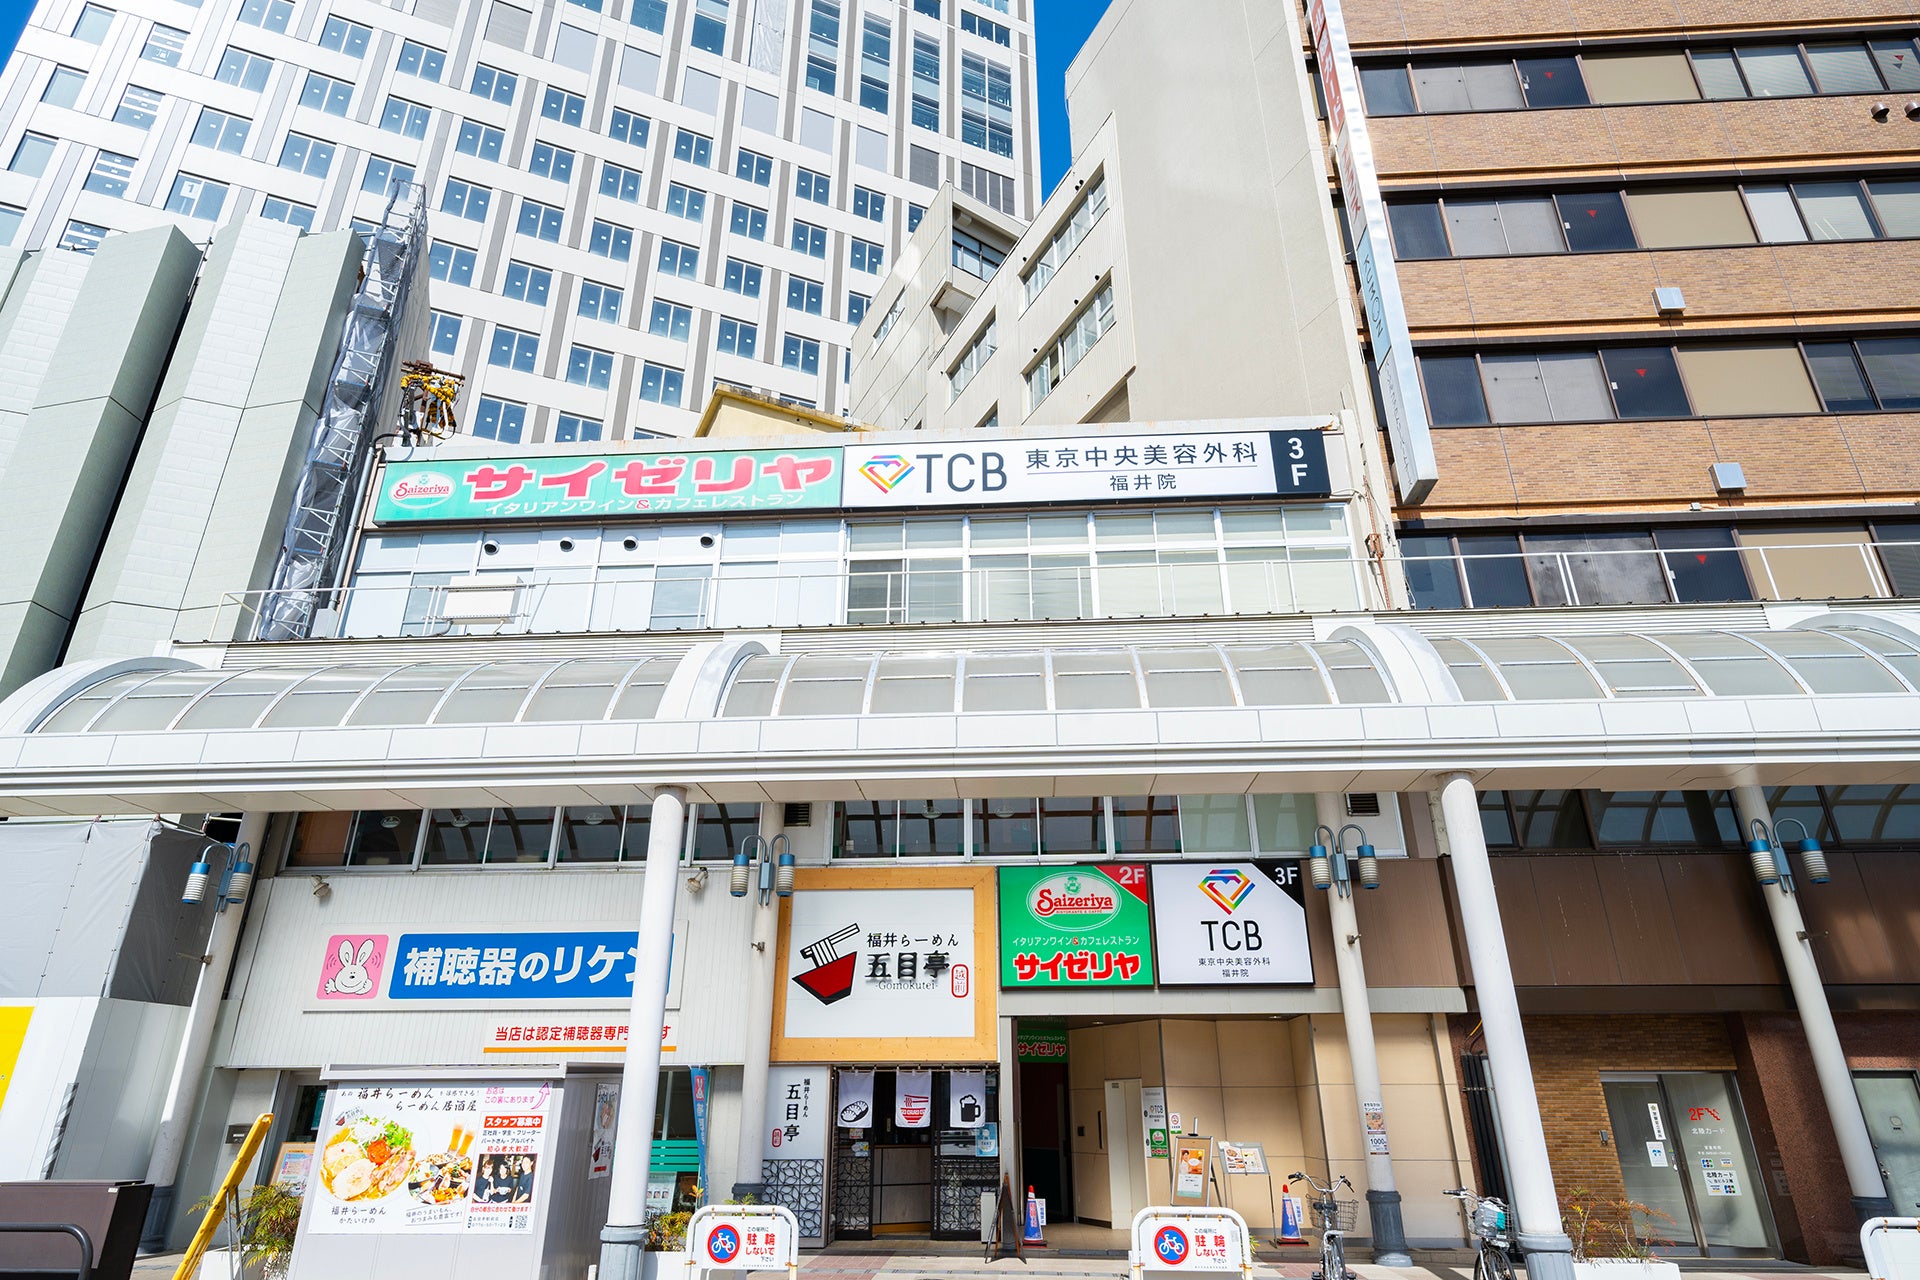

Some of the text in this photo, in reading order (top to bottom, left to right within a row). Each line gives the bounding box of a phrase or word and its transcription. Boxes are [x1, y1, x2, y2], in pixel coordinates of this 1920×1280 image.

[1363, 254, 1383, 338] KUMON
[1026, 442, 1258, 469] 東京中央美容外科
[465, 457, 834, 502] サイゼリヤ
[916, 452, 1008, 493] TCB
[394, 482, 450, 498] Saizeriya
[1109, 474, 1177, 491] 福井院
[485, 493, 804, 515] イタリアンワイン&カフェレストラン
[1119, 866, 1144, 884] 2F
[1275, 867, 1298, 885] 3F
[1035, 889, 1113, 916] Saizeriya
[867, 933, 959, 947] 福井らーめん
[1012, 935, 1140, 946] イタリアンワイン&カフェレストラン
[1200, 920, 1263, 951] TCB
[403, 945, 637, 986] 補聴器のリケ
[865, 950, 950, 979] 五目亭
[1013, 950, 1141, 981] サイゼリヤ
[1198, 957, 1271, 967] 東京中央美容外科
[1222, 969, 1249, 977] 福井院
[1018, 1042, 1066, 1056] サイゼリヤ
[357, 1088, 434, 1099] 福井らーめん
[803, 1078, 811, 1117] 福井らーめん
[396, 1100, 477, 1111] らーめん居酒屋
[784, 1084, 801, 1142] 五目亭
[1688, 1107, 1705, 1121] 2F
[486, 1117, 541, 1127] スタッフ募集中
[1692, 1127, 1725, 1135] 北陸カード
[1707, 1171, 1733, 1179] 北陸カード
[331, 1206, 386, 1216] 福井らーめん
[747, 1233, 776, 1246] 駐輪
[1195, 1235, 1226, 1247] 駐輪
[746, 1246, 775, 1256] しないで
[1196, 1248, 1226, 1257] しないで
